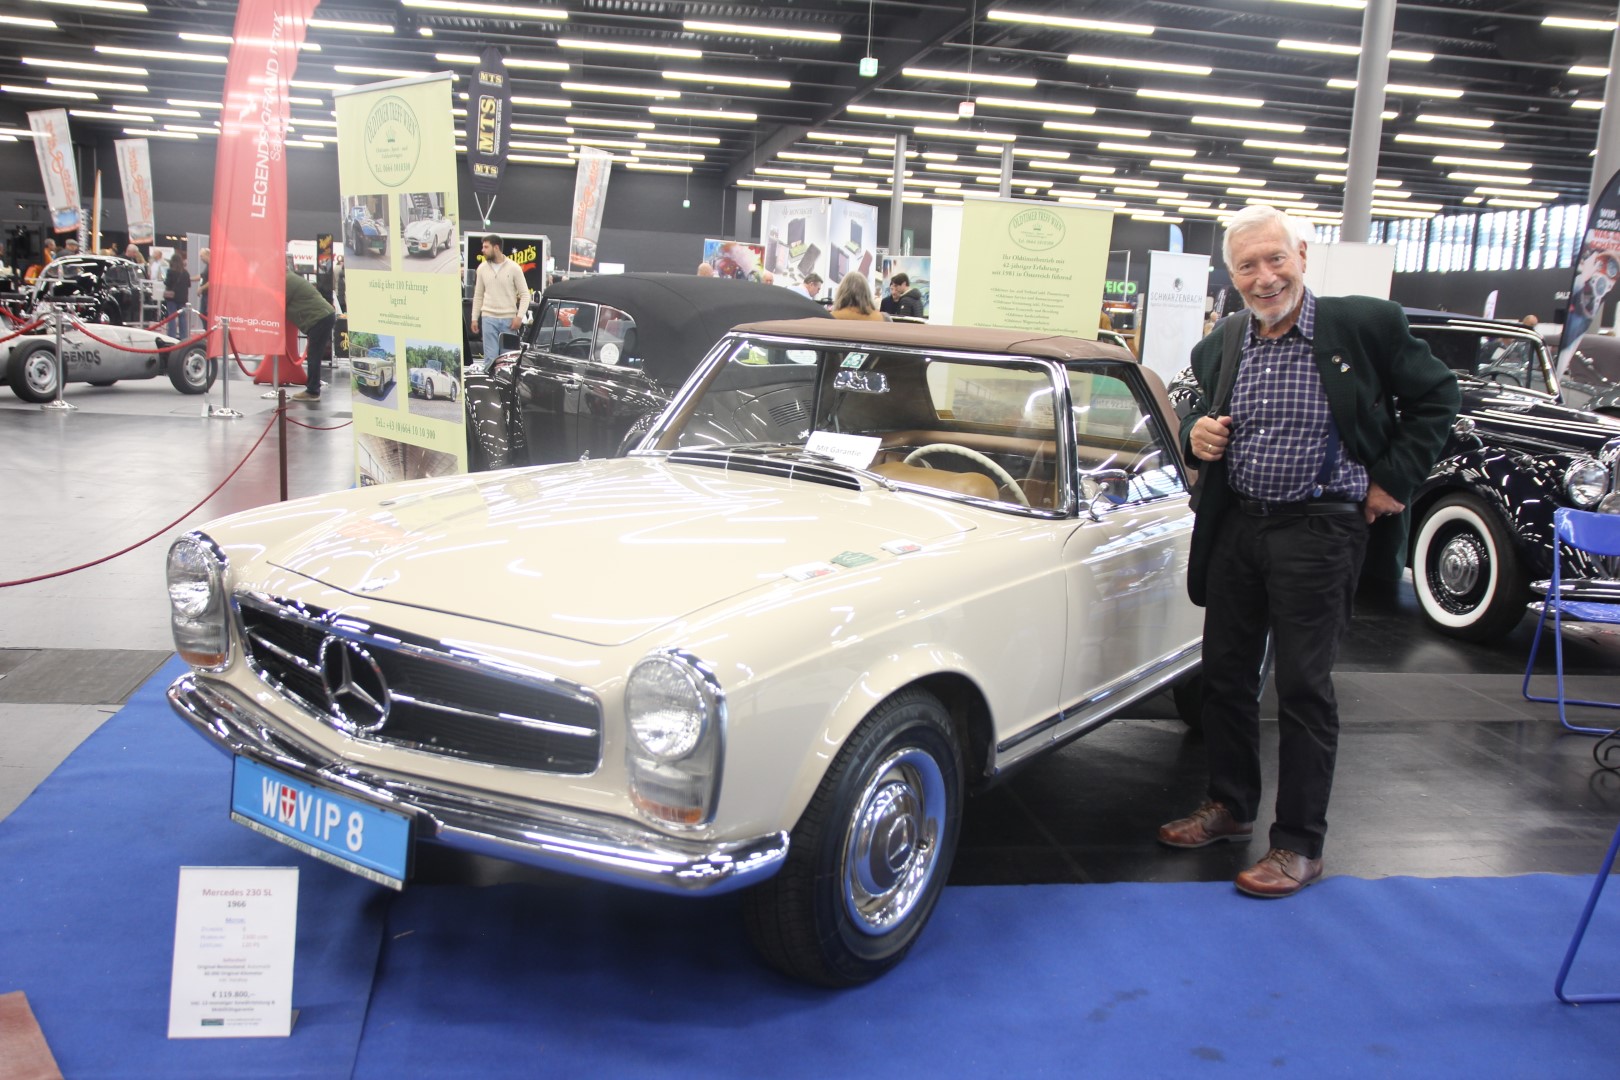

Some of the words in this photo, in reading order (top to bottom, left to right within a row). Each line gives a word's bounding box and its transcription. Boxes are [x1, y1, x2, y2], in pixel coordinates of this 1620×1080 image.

[480, 71, 503, 84] MTS
[479, 98, 495, 153] MTS
[250, 126, 270, 218] LEGENDS
[475, 163, 498, 175] MTS
[1600, 208, 1616, 219] WIR
[1596, 218, 1620, 231] SCHÜ
[1105, 281, 1137, 295] EICO
[1150, 291, 1203, 303] SCHWARZENBACH
[62, 349, 101, 366] GENDS
[816, 444, 828, 452] Mit
[830, 446, 862, 457] Garantie
[262, 776, 280, 819] W
[298, 790, 341, 841] VIP
[346, 811, 364, 852] 8
[202, 888, 244, 897] Mercedes
[245, 888, 262, 897] 230
[227, 900, 247, 908] 1966
